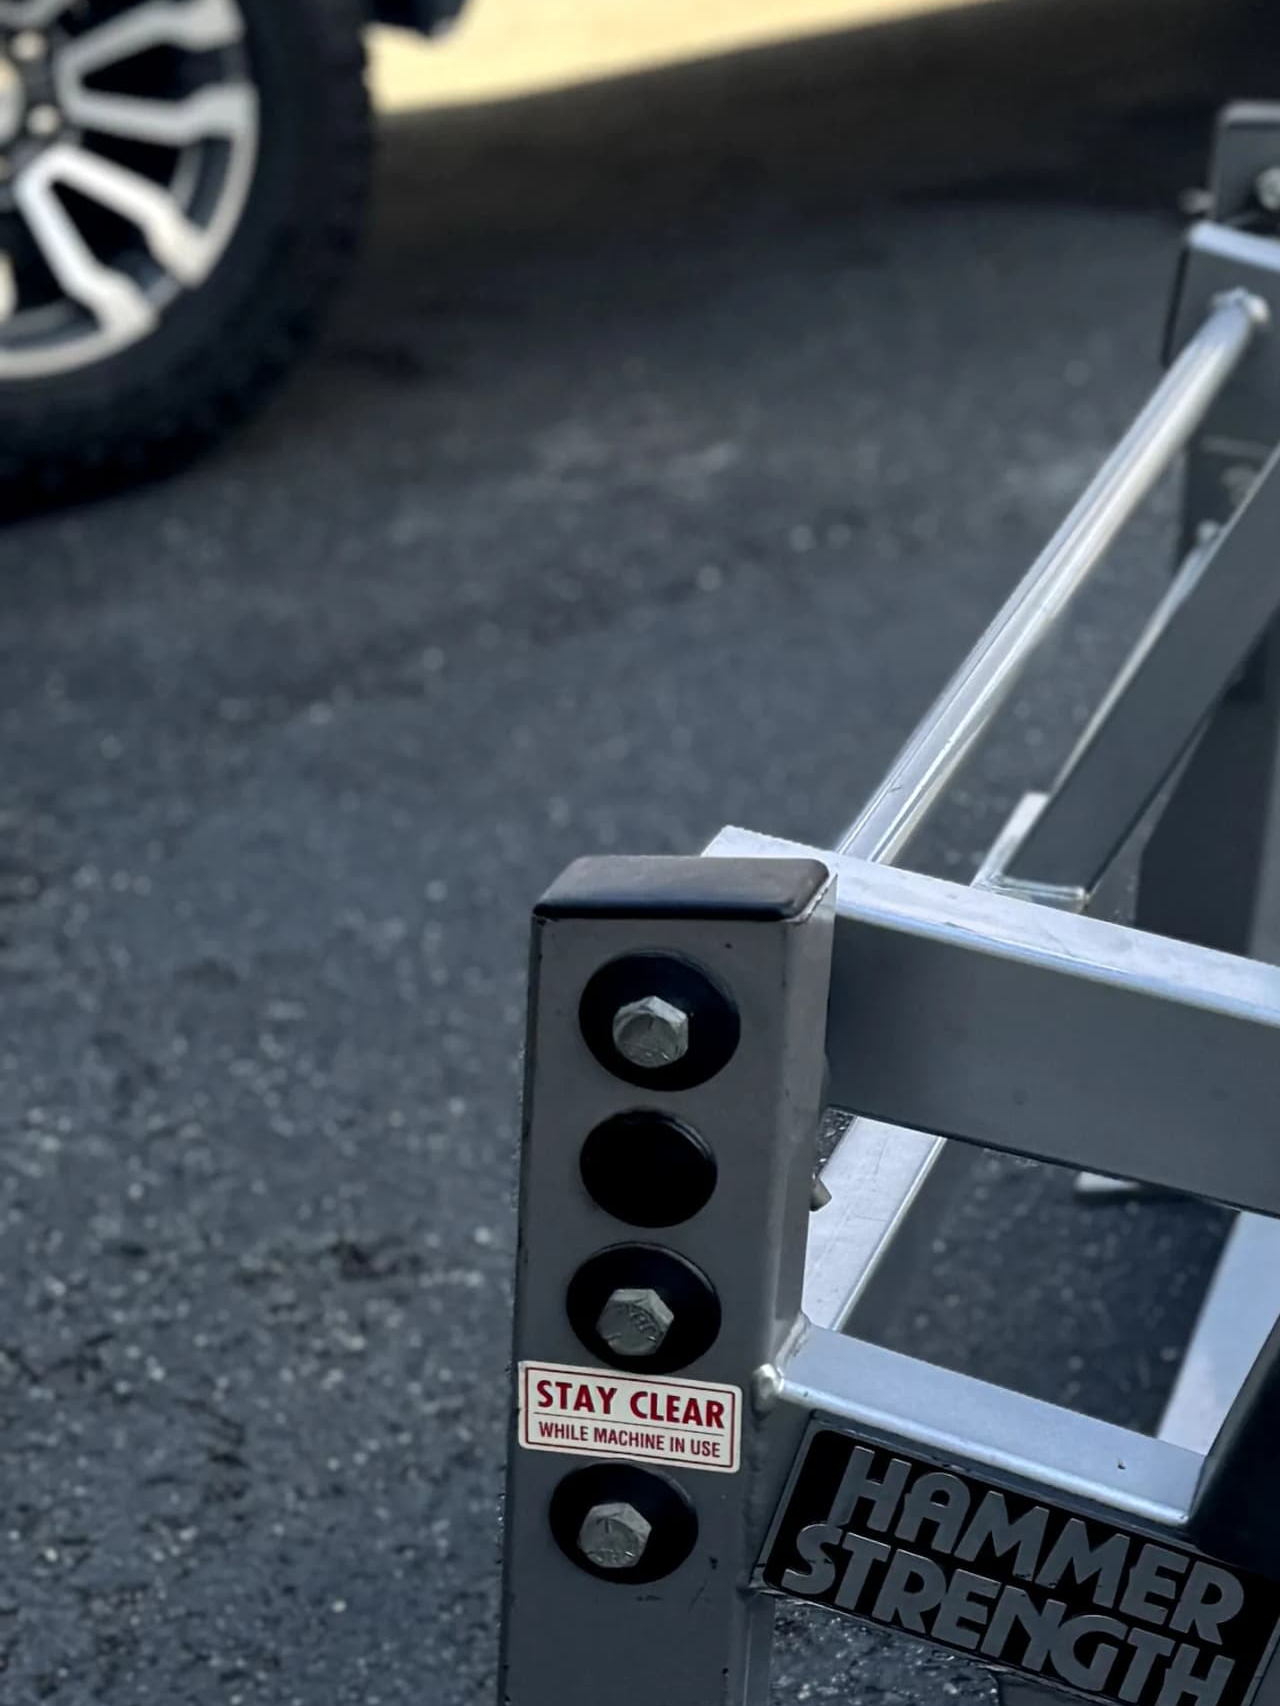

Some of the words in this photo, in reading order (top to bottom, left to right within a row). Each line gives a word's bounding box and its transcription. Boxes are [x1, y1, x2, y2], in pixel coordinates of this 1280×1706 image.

[536, 1379, 617, 1415] STAY
[629, 1391, 725, 1429] CLEAR
[538, 1421, 589, 1442] WHILE
[593, 1427, 665, 1452] MACHINE
[669, 1436, 686, 1454] IN
[690, 1439, 721, 1458] USE
[827, 1445, 1245, 1646] HAMMER
